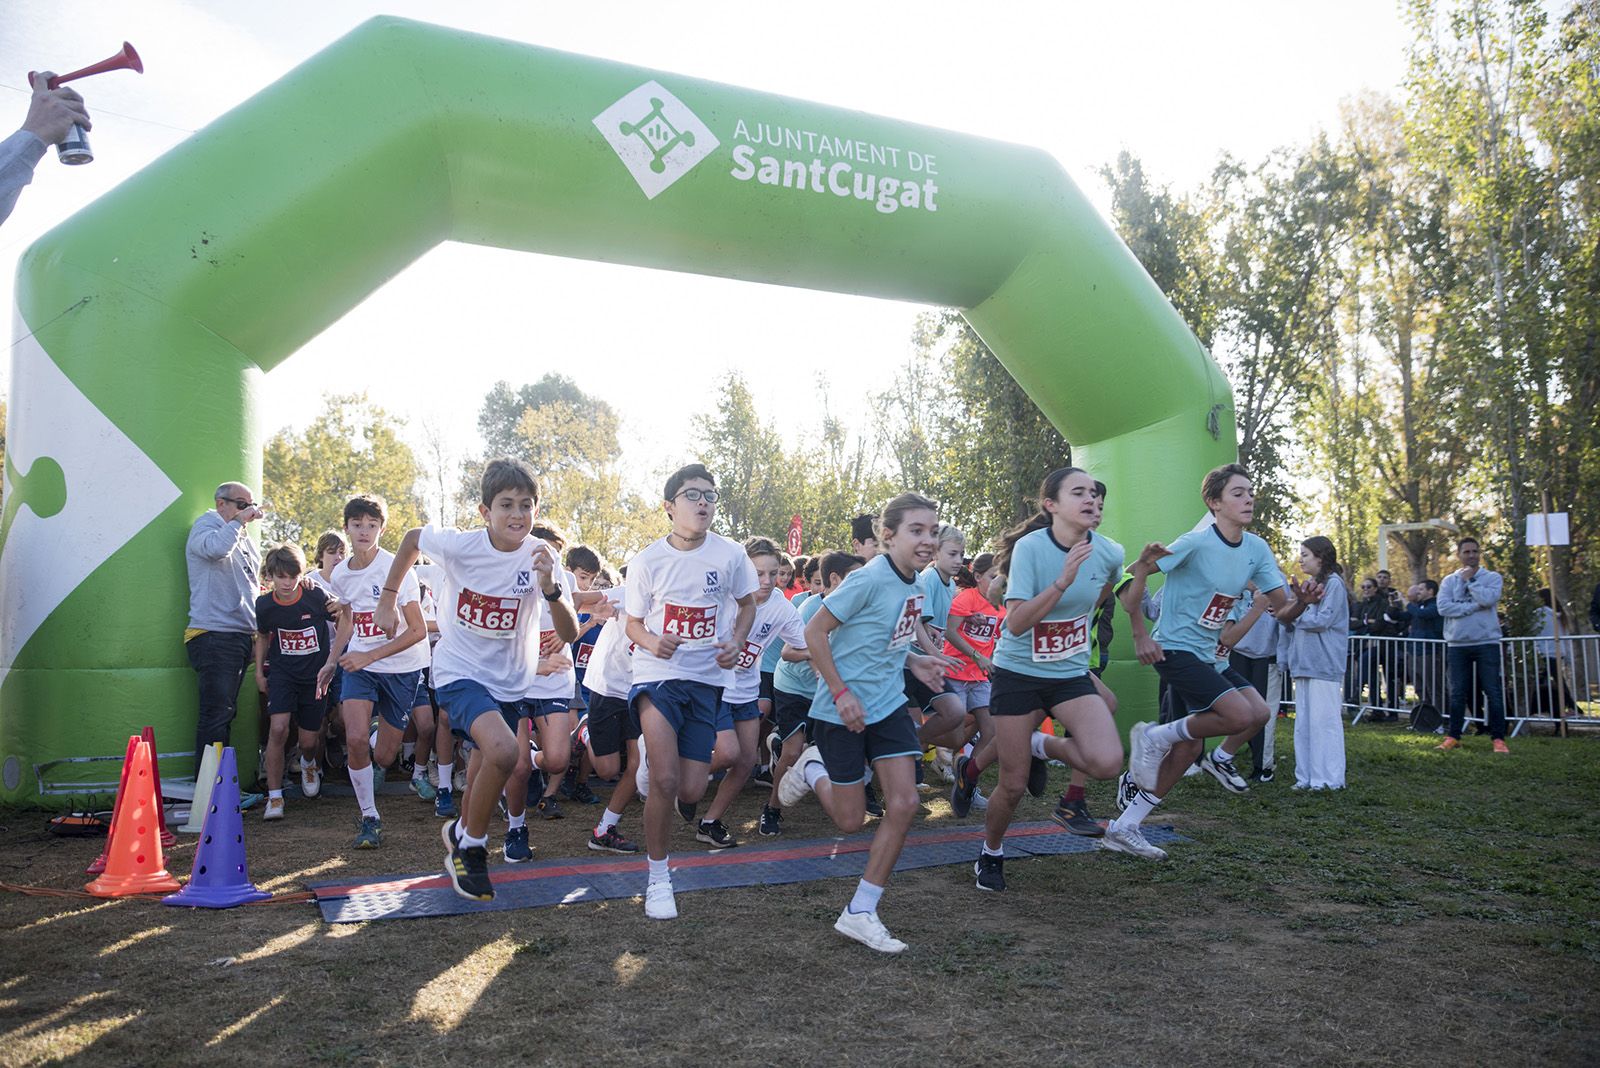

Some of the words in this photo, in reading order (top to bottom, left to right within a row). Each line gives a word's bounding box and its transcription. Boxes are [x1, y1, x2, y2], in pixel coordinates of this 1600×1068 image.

[733, 119, 901, 168] AJUNTAMENT
[907, 151, 939, 175] DE
[730, 144, 938, 213] SantCugat
[459, 603, 515, 629] 4168
[666, 618, 715, 638] 4165
[281, 637, 316, 650] 3734
[1038, 627, 1085, 652] 1304
